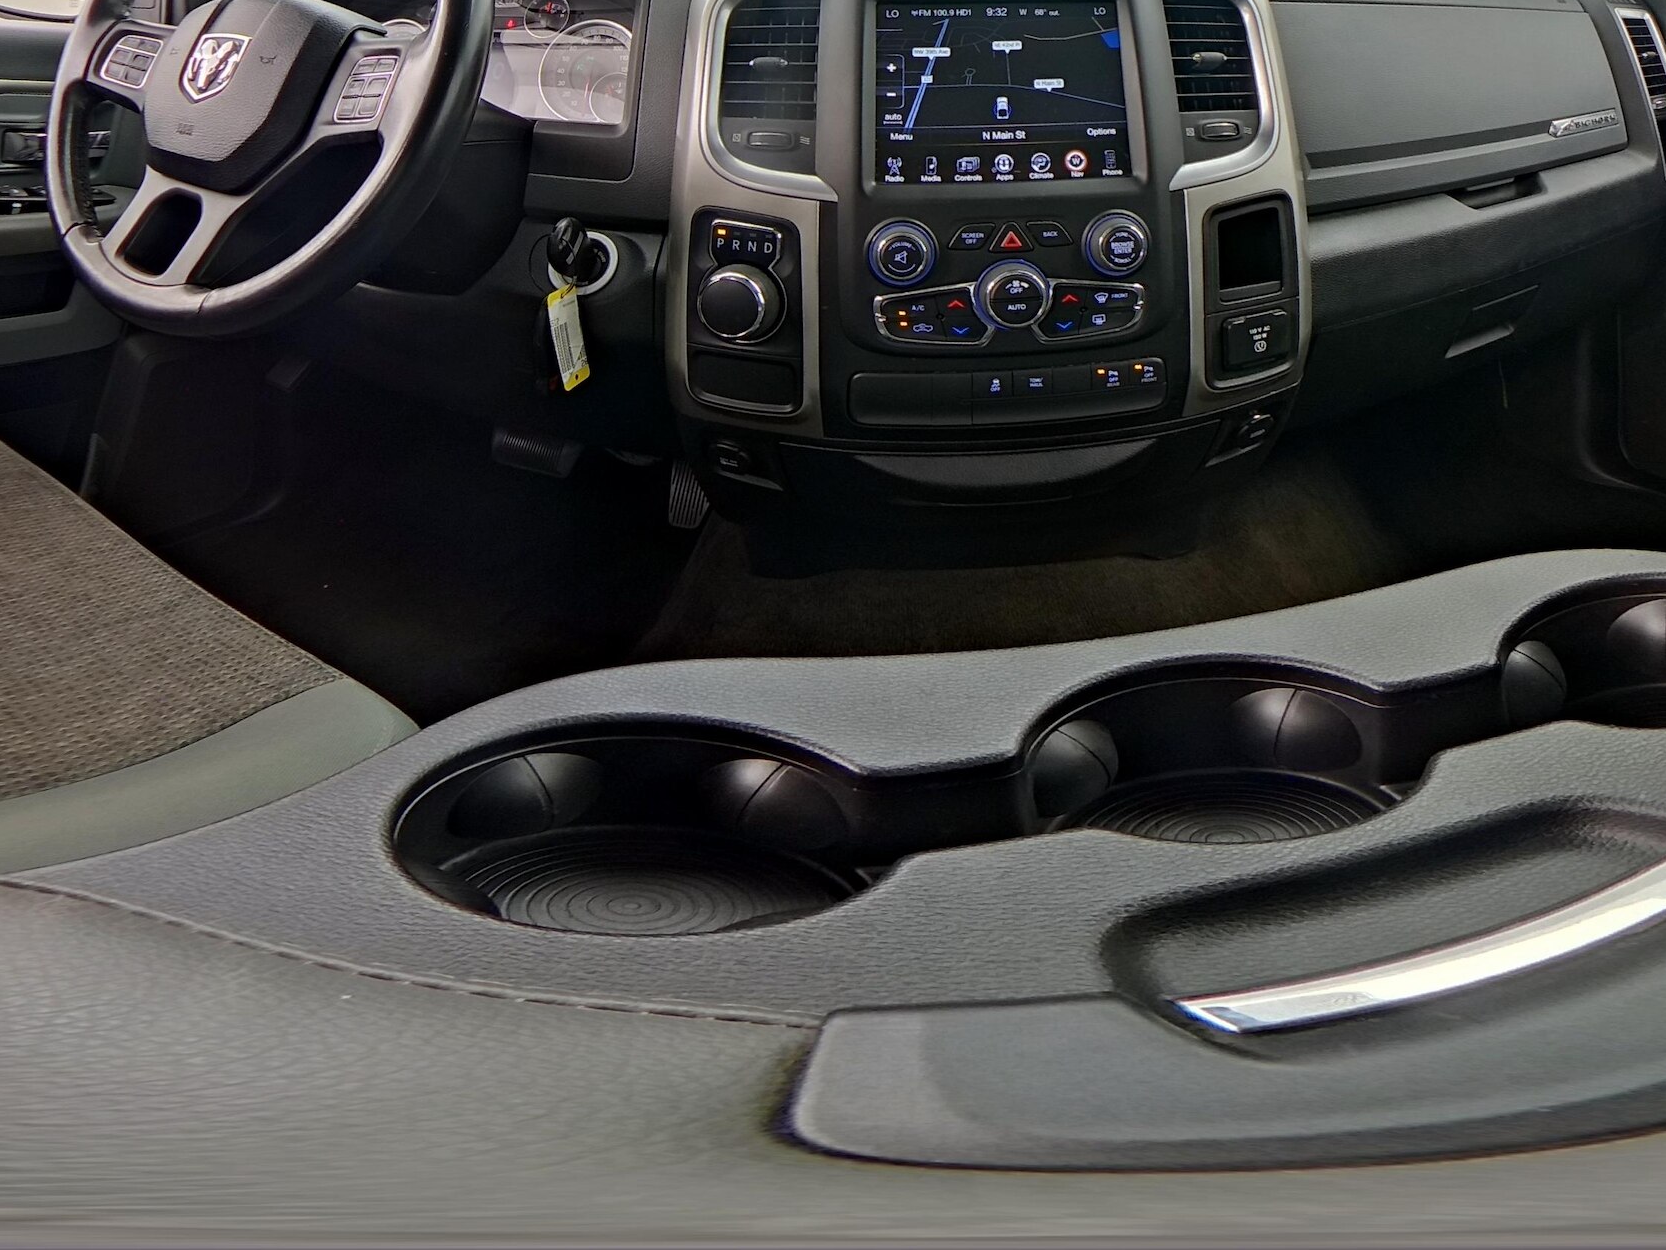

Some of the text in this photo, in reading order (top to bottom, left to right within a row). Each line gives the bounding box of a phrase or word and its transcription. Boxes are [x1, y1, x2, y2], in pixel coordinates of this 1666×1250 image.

[885, 9, 900, 18] LO
[918, 9, 972, 17] FM 100.9 HD1
[986, 7, 1007, 17] 9:32
[1094, 7, 1106, 15] LO
[884, 113, 902, 121] auto
[890, 132, 913, 141] Menu
[982, 130, 1026, 140] N Main St
[1086, 127, 1117, 137] Options
[1029, 171, 1054, 180] Climate
[1070, 170, 1084, 178] Nav
[1102, 168, 1123, 177] Phone
[884, 174, 905, 183] Radio
[920, 174, 942, 183] Media
[954, 174, 983, 182] Controls
[995, 173, 1014, 182] Apps
[1042, 230, 1059, 238] BACK
[716, 237, 774, 254] P R N D
[1010, 287, 1024, 295] OFF
[1007, 303, 1027, 311] AUTO
